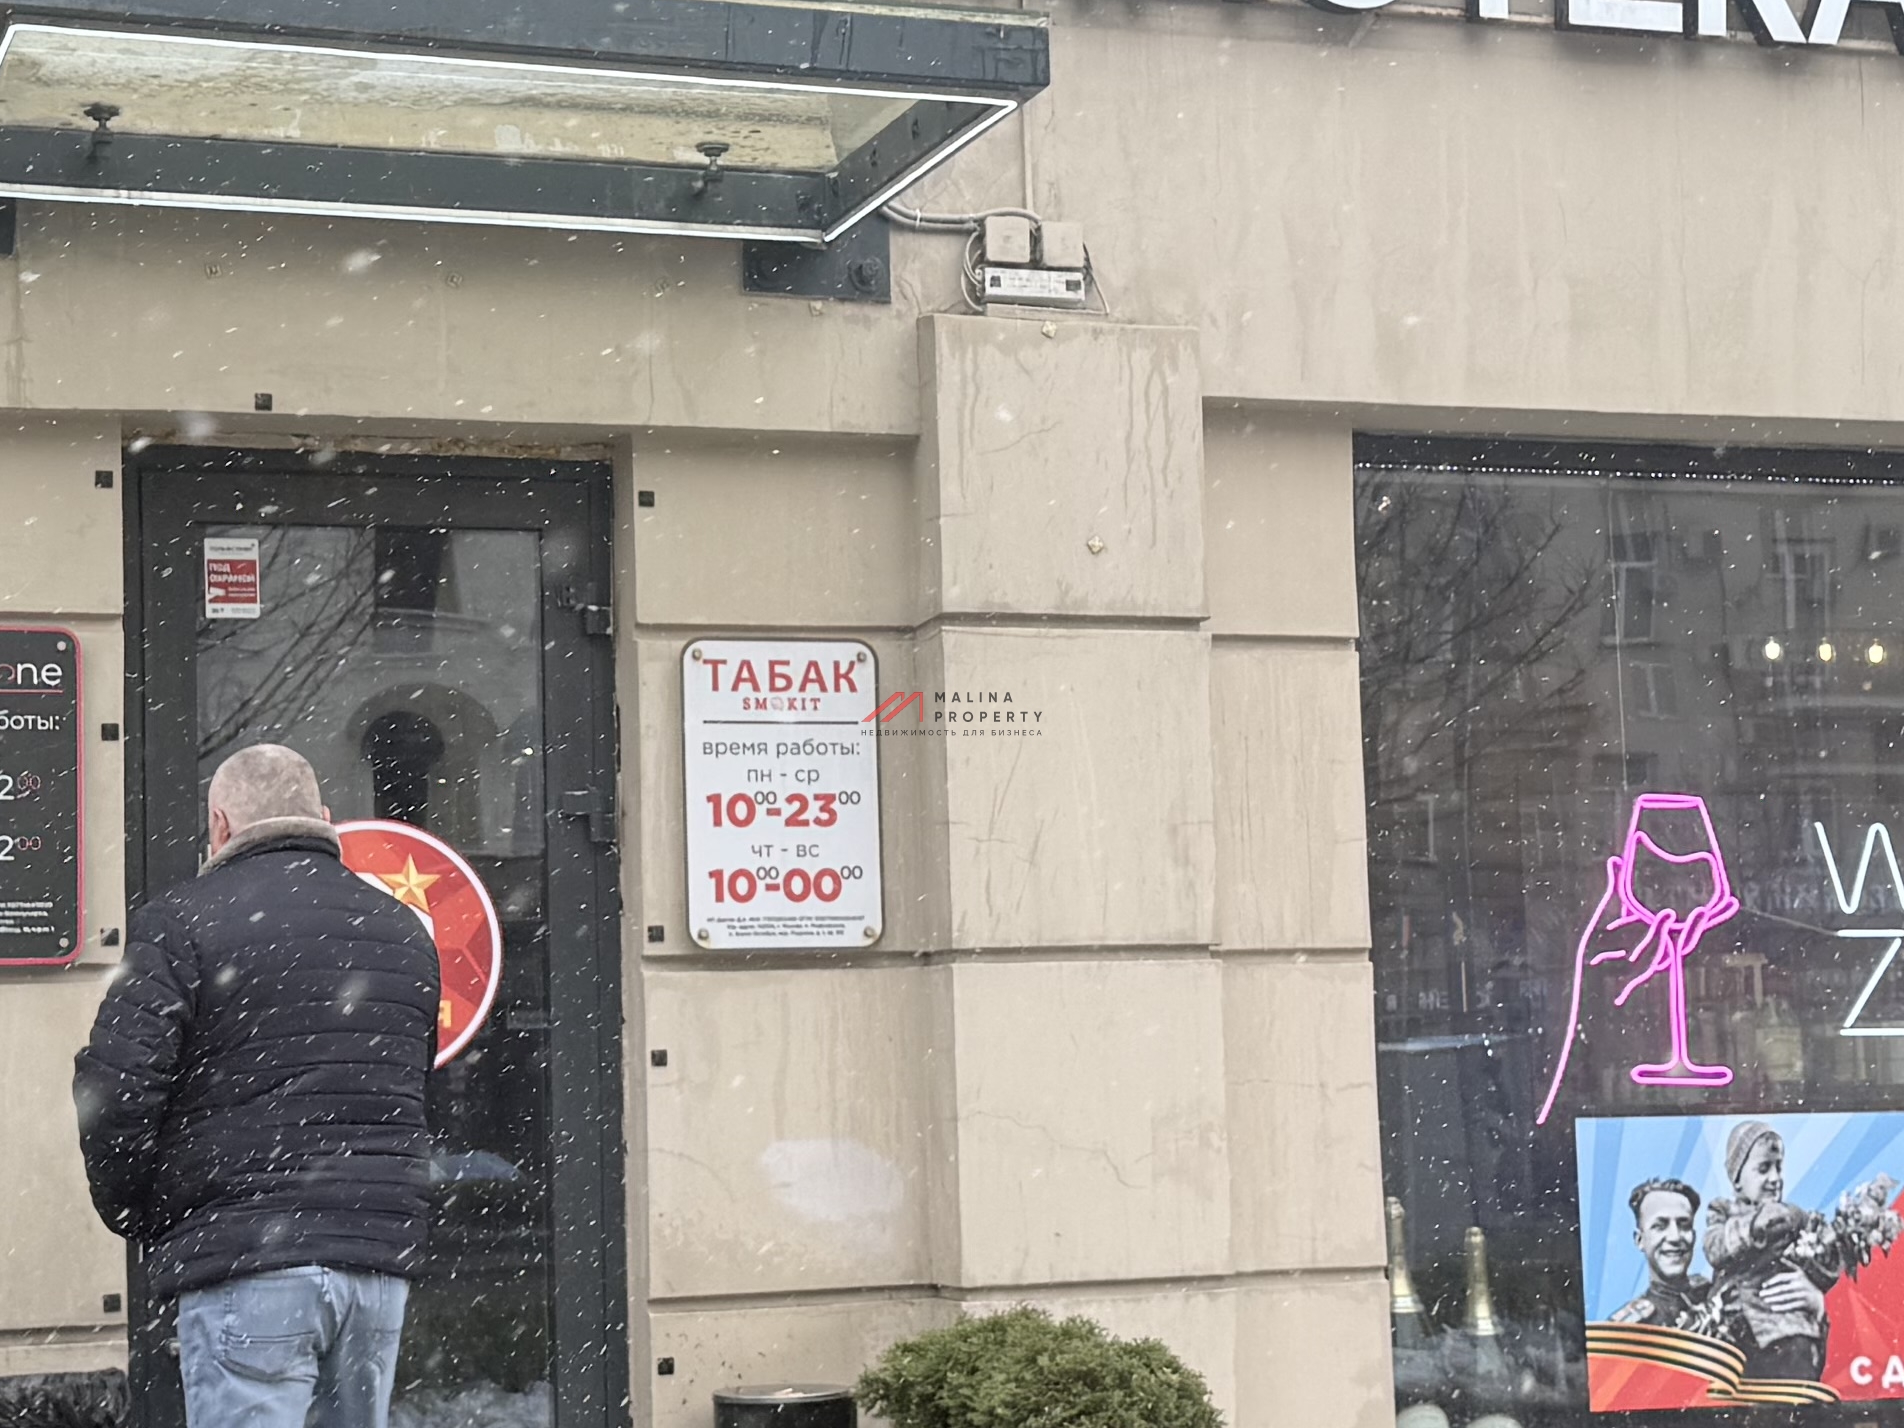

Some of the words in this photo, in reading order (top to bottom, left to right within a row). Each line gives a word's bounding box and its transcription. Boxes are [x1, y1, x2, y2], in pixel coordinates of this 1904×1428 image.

[702, 658, 859, 694] ТАБАК
[702, 741, 769, 759] время
[776, 738, 861, 760] работы:
[747, 768, 772, 783] пн
[794, 768, 820, 785] ср
[750, 844, 773, 858] чт
[795, 844, 820, 858] вс
[1849, 1356, 1874, 1386] С
